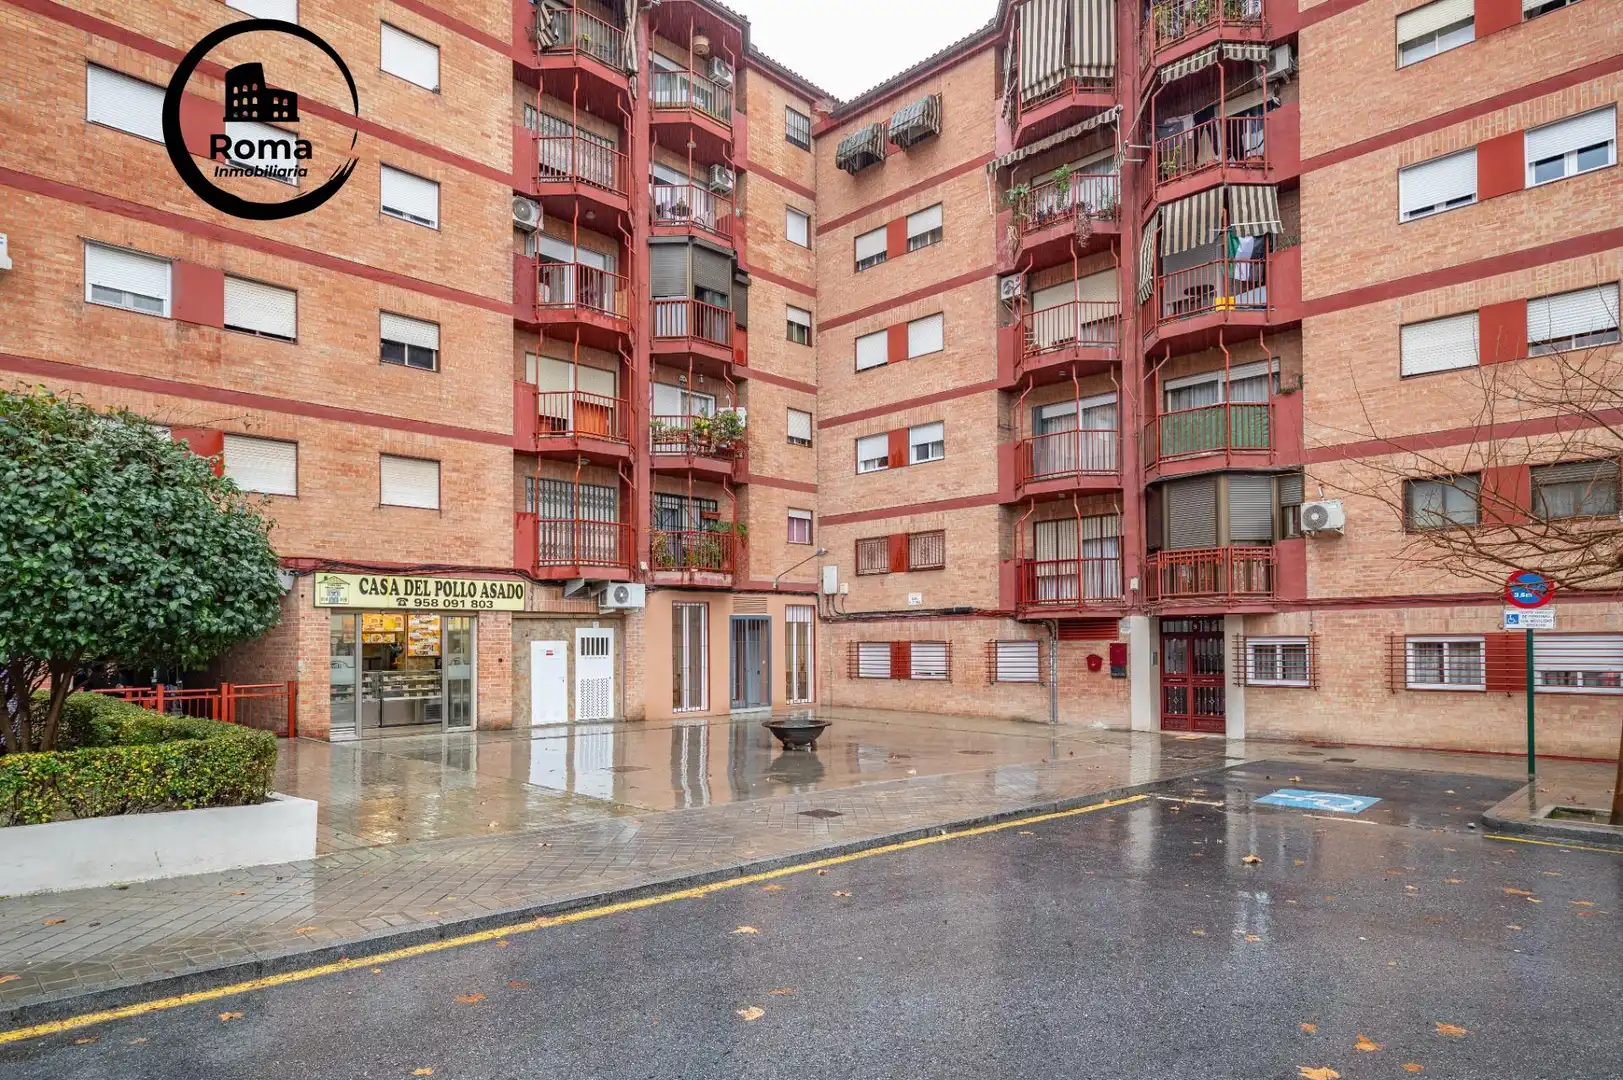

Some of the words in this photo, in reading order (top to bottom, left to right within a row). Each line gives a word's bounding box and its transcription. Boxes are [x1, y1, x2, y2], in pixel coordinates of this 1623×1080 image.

[359, 577, 400, 595] CASA
[403, 579, 431, 596] DEL
[434, 580, 477, 598] POLLO
[480, 582, 523, 599] ASADO
[414, 598, 439, 607] 958
[443, 599, 465, 608] 091
[471, 600, 493, 608] 803
